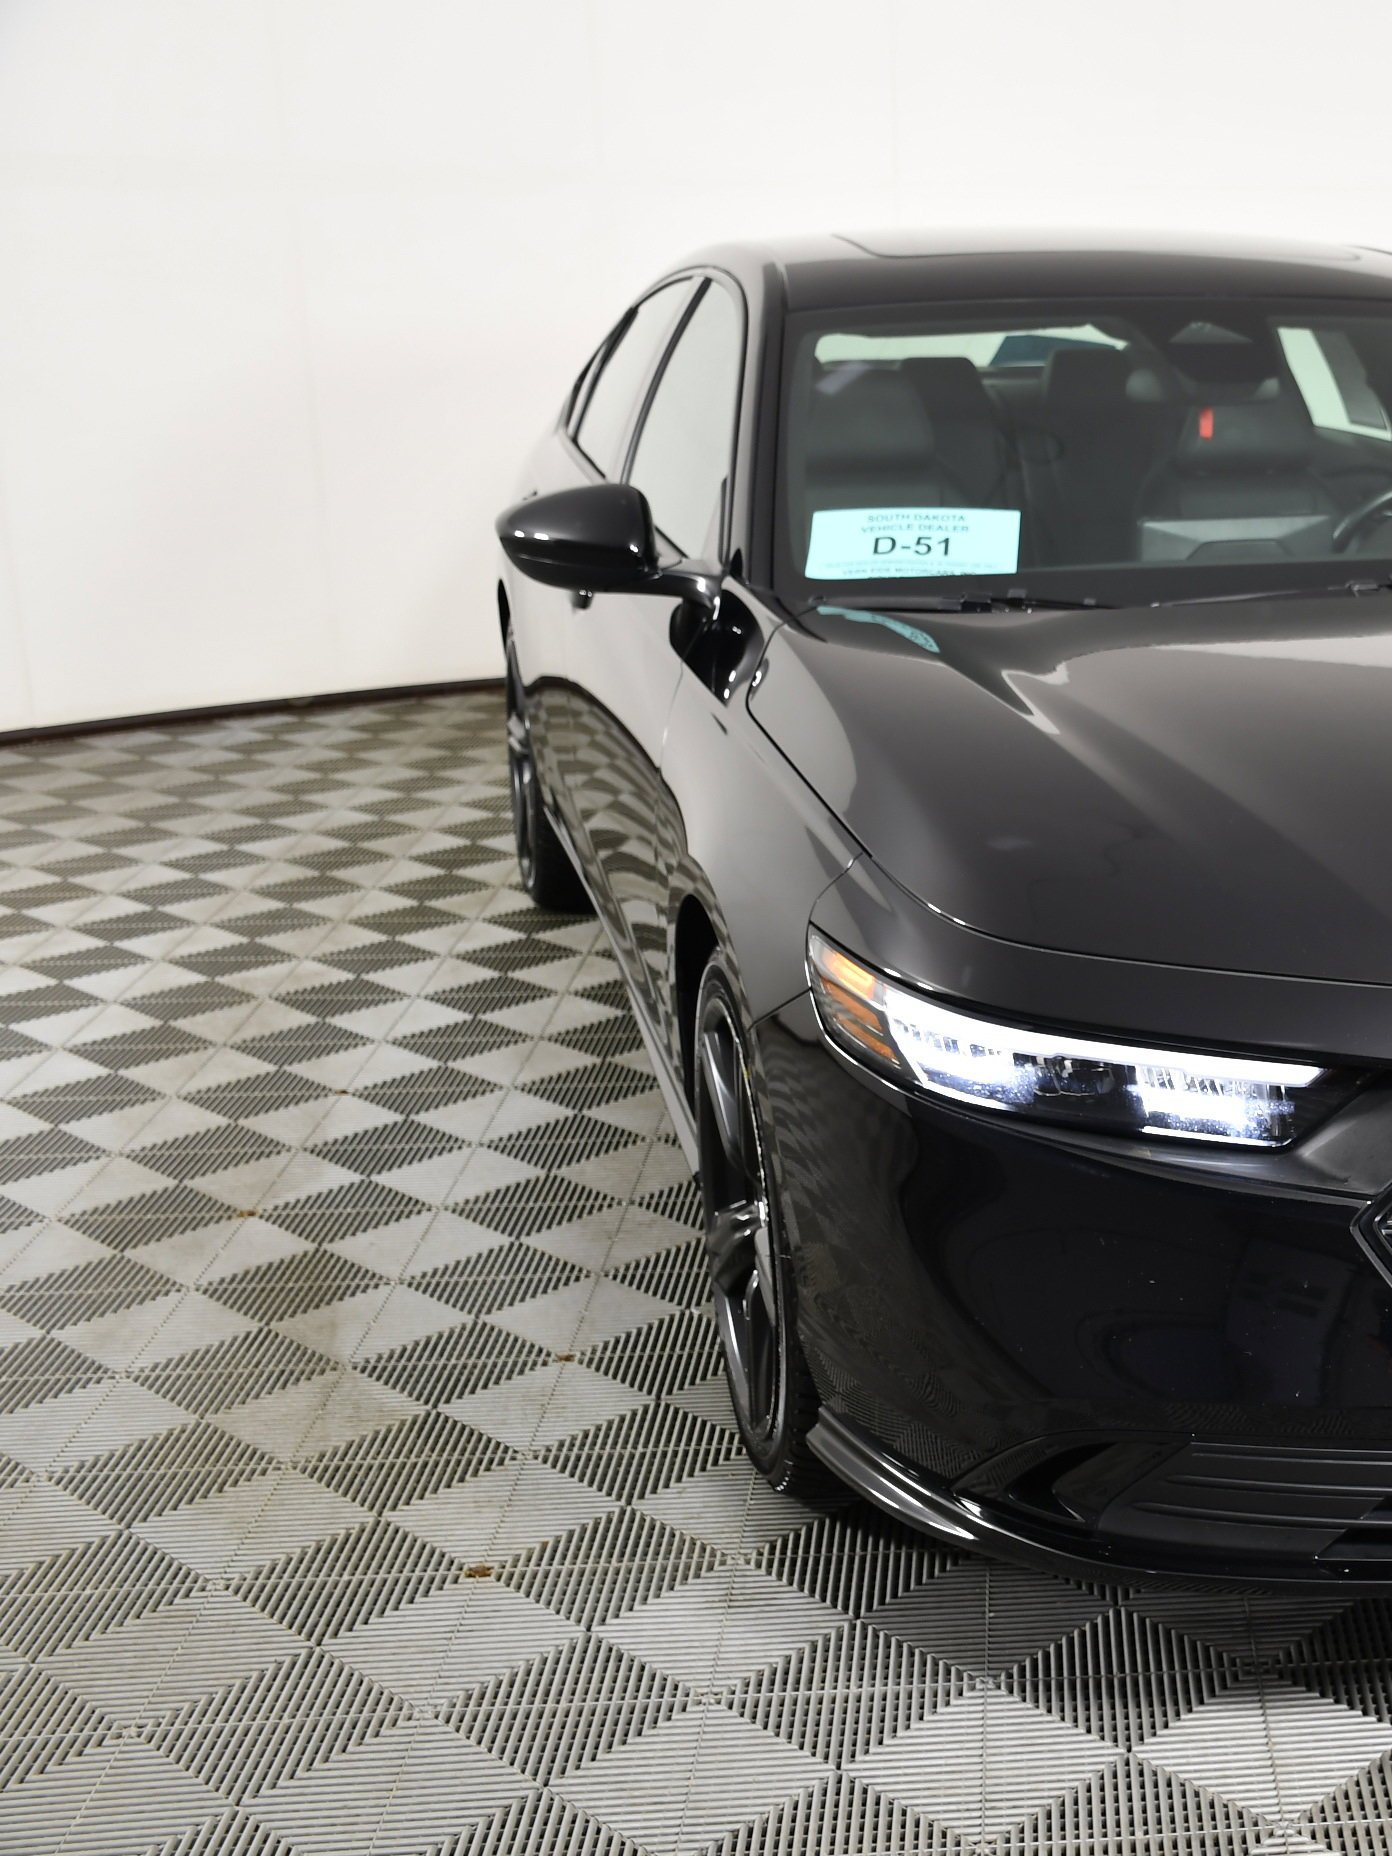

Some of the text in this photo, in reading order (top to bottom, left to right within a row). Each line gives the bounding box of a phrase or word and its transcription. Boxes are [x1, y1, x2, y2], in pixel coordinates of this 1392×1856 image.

[914, 513, 966, 523] DAKOTA
[918, 524, 969, 533] DEALER
[872, 536, 951, 556] D-51
